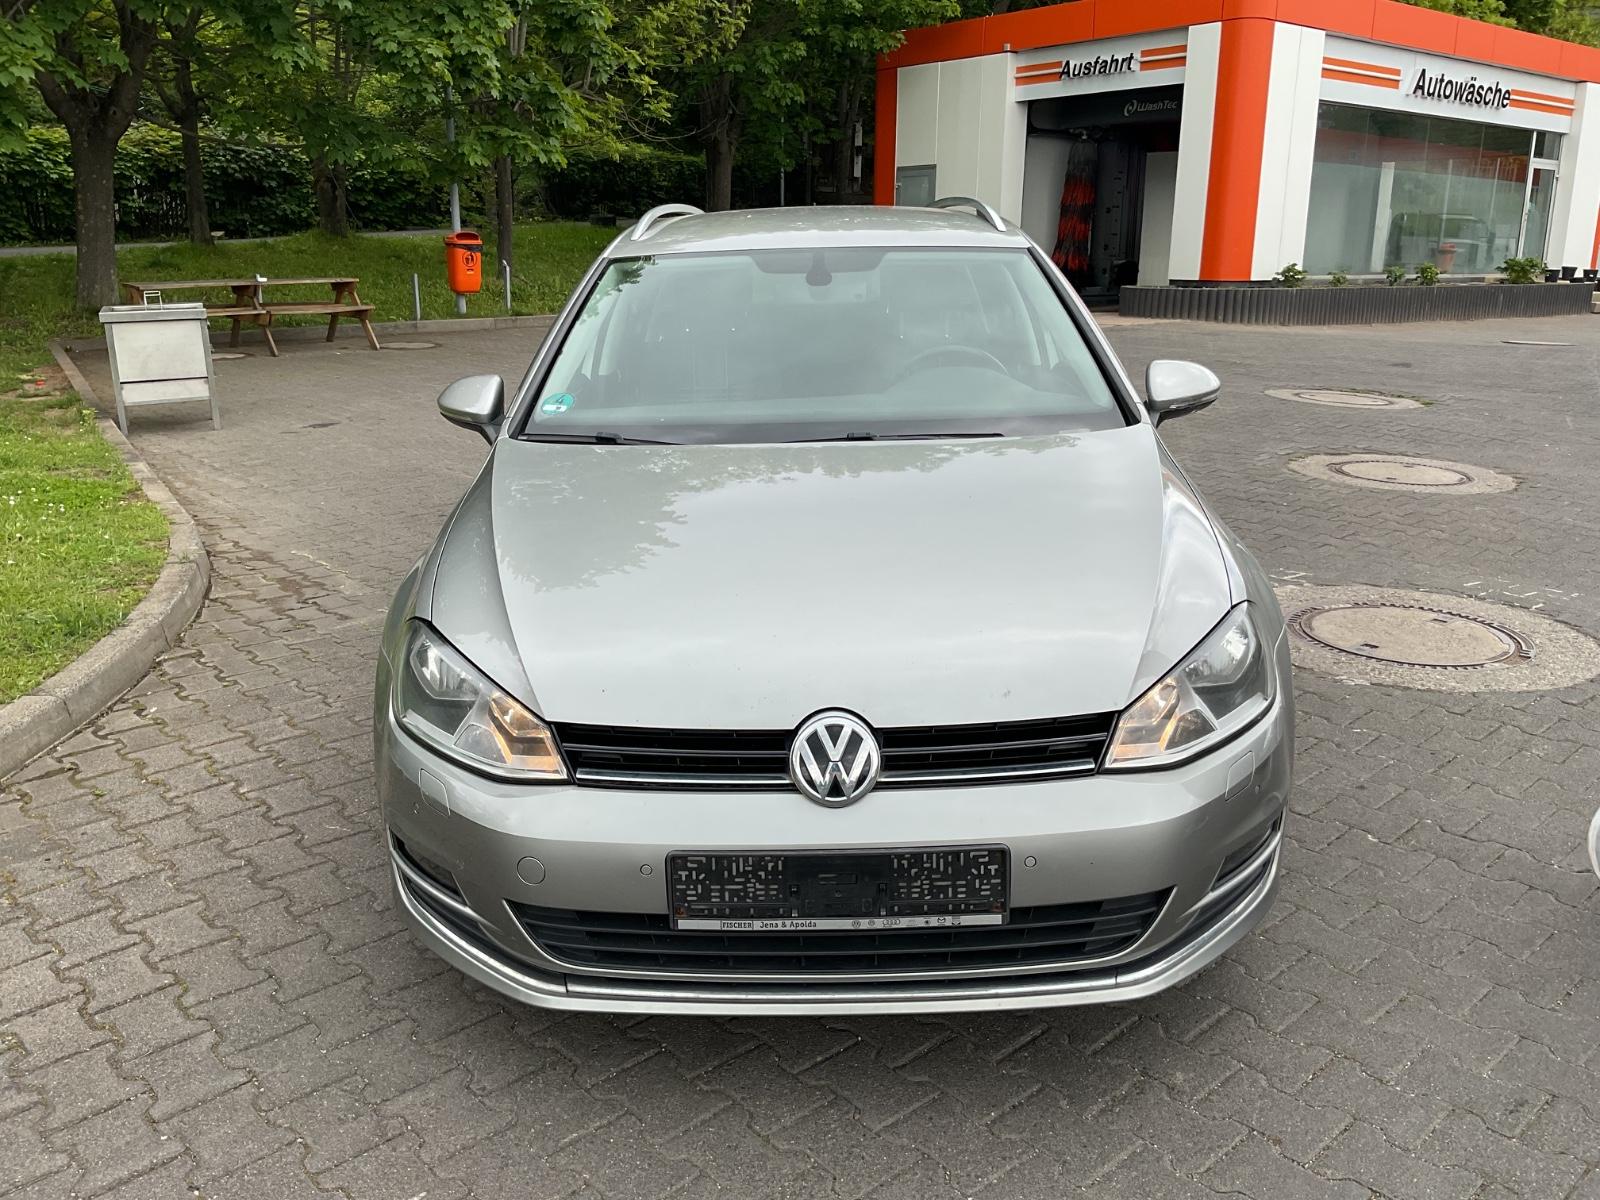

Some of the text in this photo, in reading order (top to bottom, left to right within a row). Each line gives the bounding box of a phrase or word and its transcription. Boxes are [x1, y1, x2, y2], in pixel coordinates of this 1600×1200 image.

[1059, 53, 1134, 79] Ausfahrt
[1412, 68, 1511, 109] Autowäsche
[721, 920, 753, 929] FISCHER
[759, 920, 779, 929] Jena
[789, 920, 817, 930] Apolda
